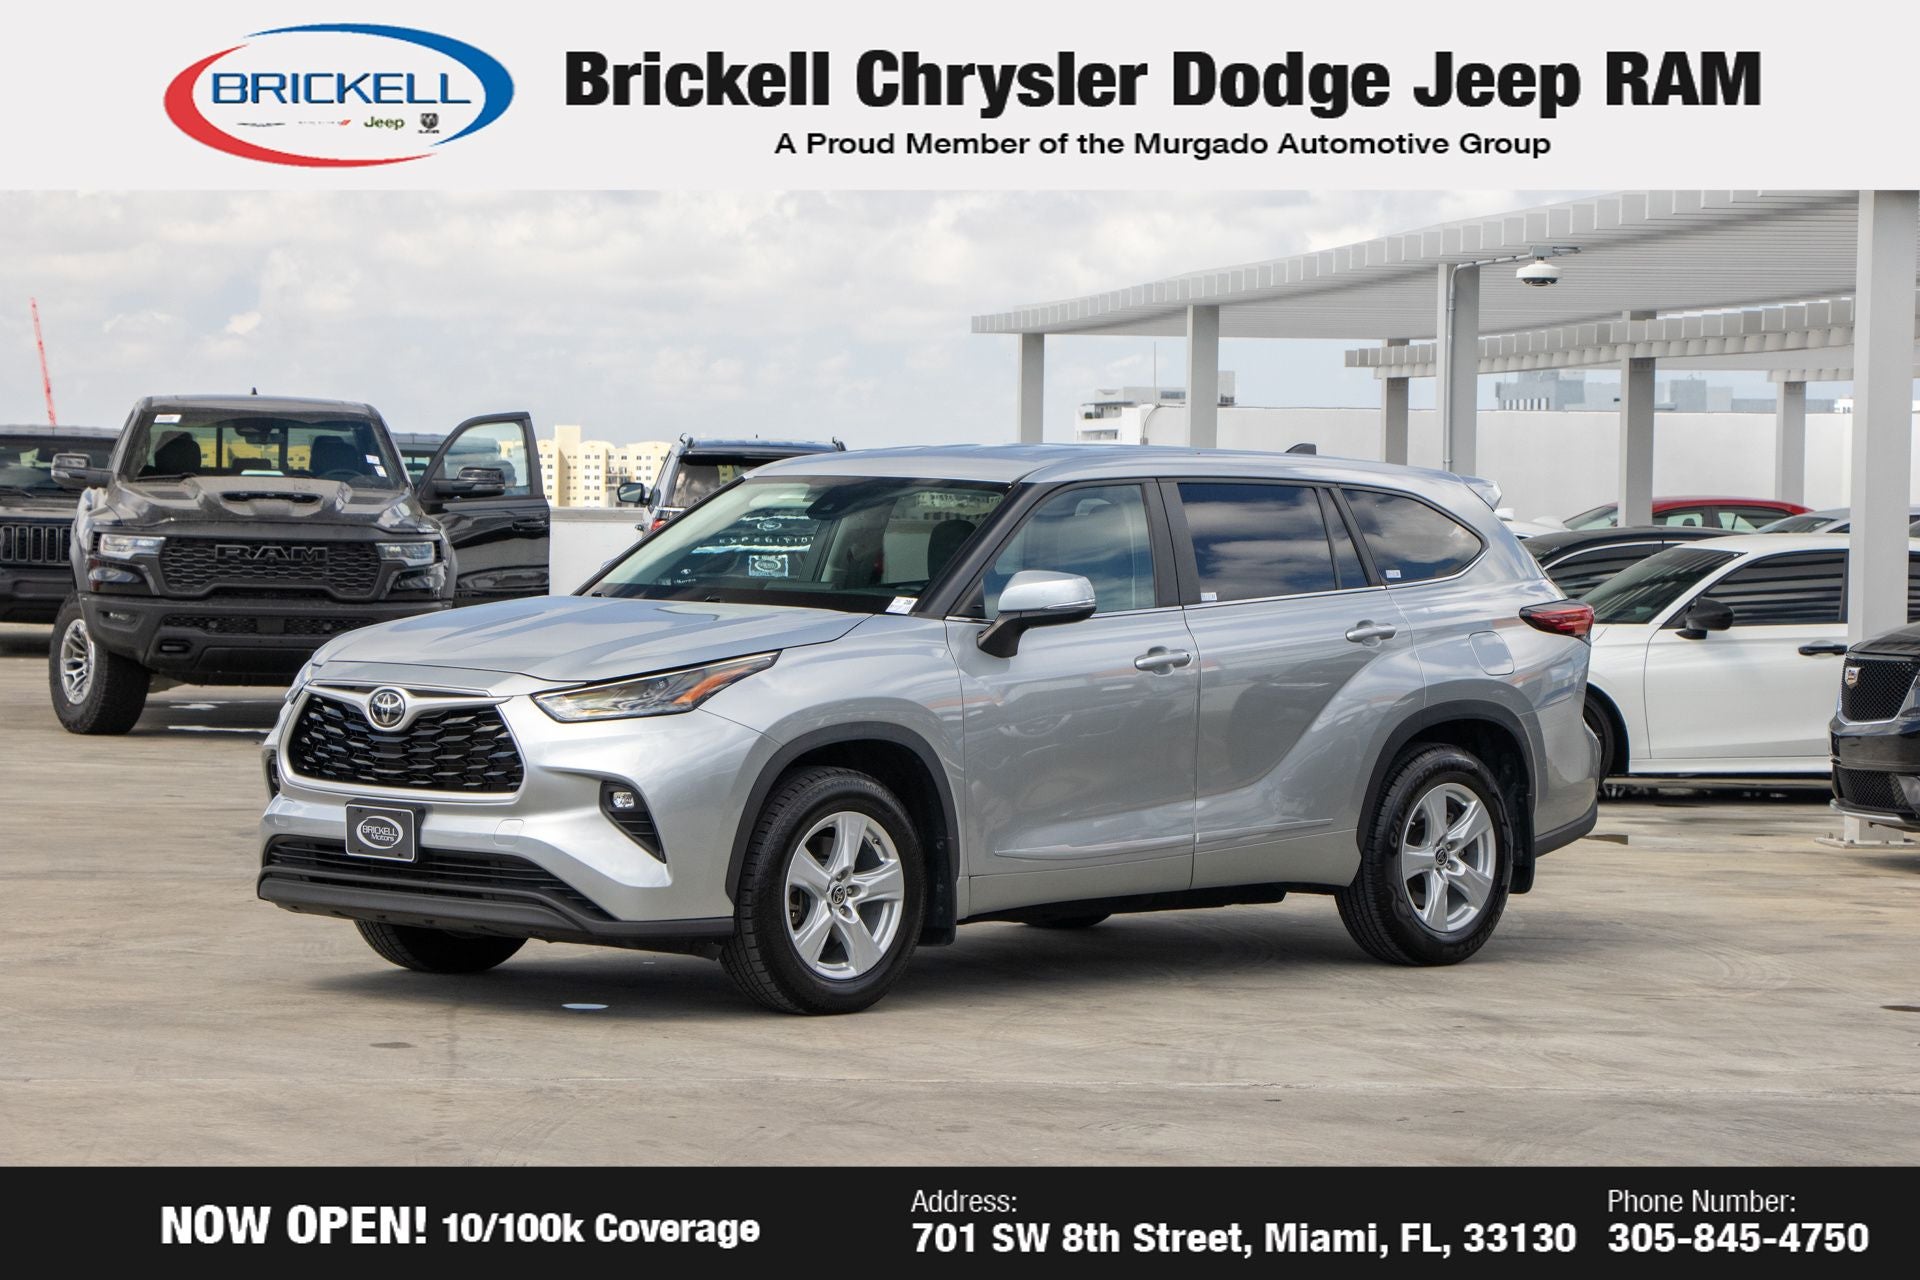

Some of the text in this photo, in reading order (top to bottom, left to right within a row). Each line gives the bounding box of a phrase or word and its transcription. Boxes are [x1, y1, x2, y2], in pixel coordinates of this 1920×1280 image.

[215, 545, 328, 561] RAM
[362, 825, 398, 836] BRICKELL
[371, 833, 395, 842] Motors
